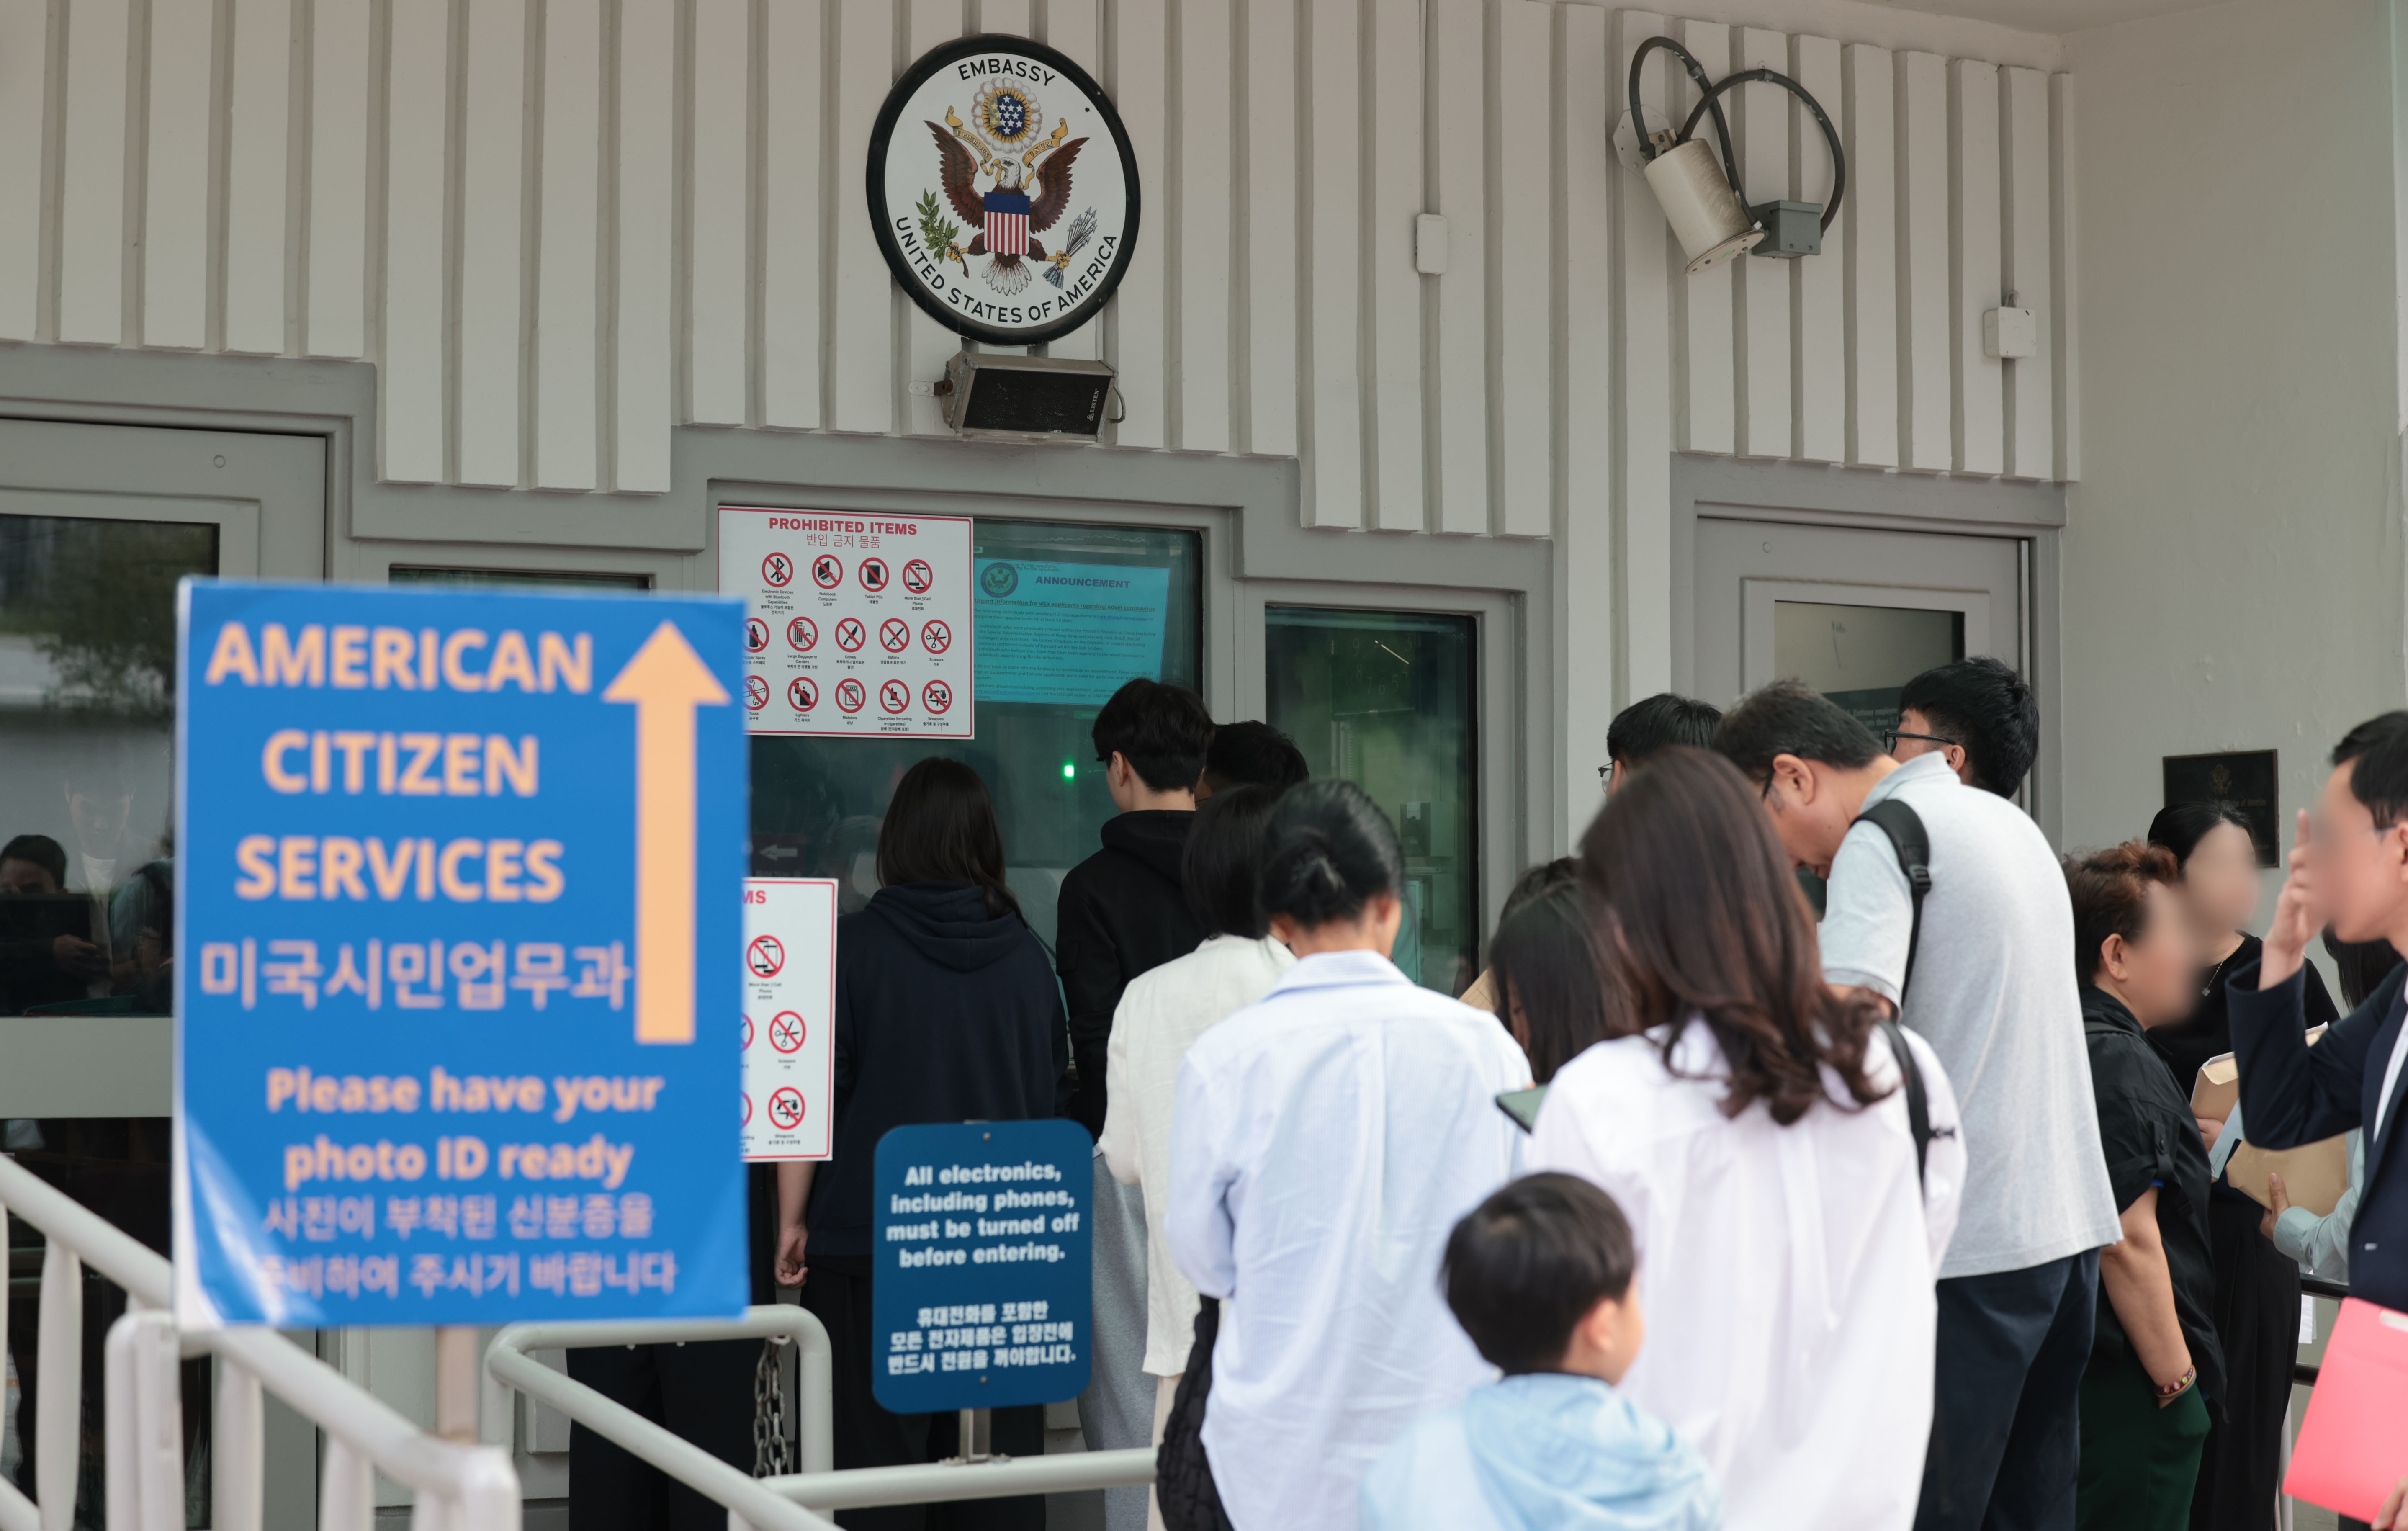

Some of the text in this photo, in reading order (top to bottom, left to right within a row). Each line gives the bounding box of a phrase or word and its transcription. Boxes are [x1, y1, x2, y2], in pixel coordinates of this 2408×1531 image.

[958, 59, 1055, 86] EMBASSY
[962, 133, 989, 157] PLURIBUS
[1028, 140, 1053, 158] UNUM
[896, 217, 1117, 323] UNITED STATES OF AMERICA
[769, 517, 917, 535] PROHIBITED ITEMS
[806, 534, 880, 548] 반입 금지 물품
[1035, 576, 1130, 588] ANNOUNCEMENT
[204, 621, 592, 695] AMERICAN
[1353, 638, 1360, 657] 9
[1356, 663, 1362, 681] 8
[1392, 674, 1399, 693] 5
[1366, 677, 1372, 695] 7
[1379, 677, 1386, 696] 6
[262, 728, 539, 797] CITIZEN
[235, 834, 565, 902] SERVICES
[200, 937, 633, 1011] 미국시민업무과
[266, 1066, 665, 1124] Please have your
[284, 1134, 634, 1191] photo ID ready
[904, 1161, 1062, 1186] All electronics,
[891, 1189, 1075, 1214] including phones,
[263, 1194, 375, 1242] 사진이
[886, 1212, 1080, 1241] must be turned off
[899, 1241, 1065, 1268] before entering.
[409, 1252, 520, 1299] 주시기
[530, 1250, 677, 1297] 바랍니다
[890, 1330, 923, 1352] 모든
